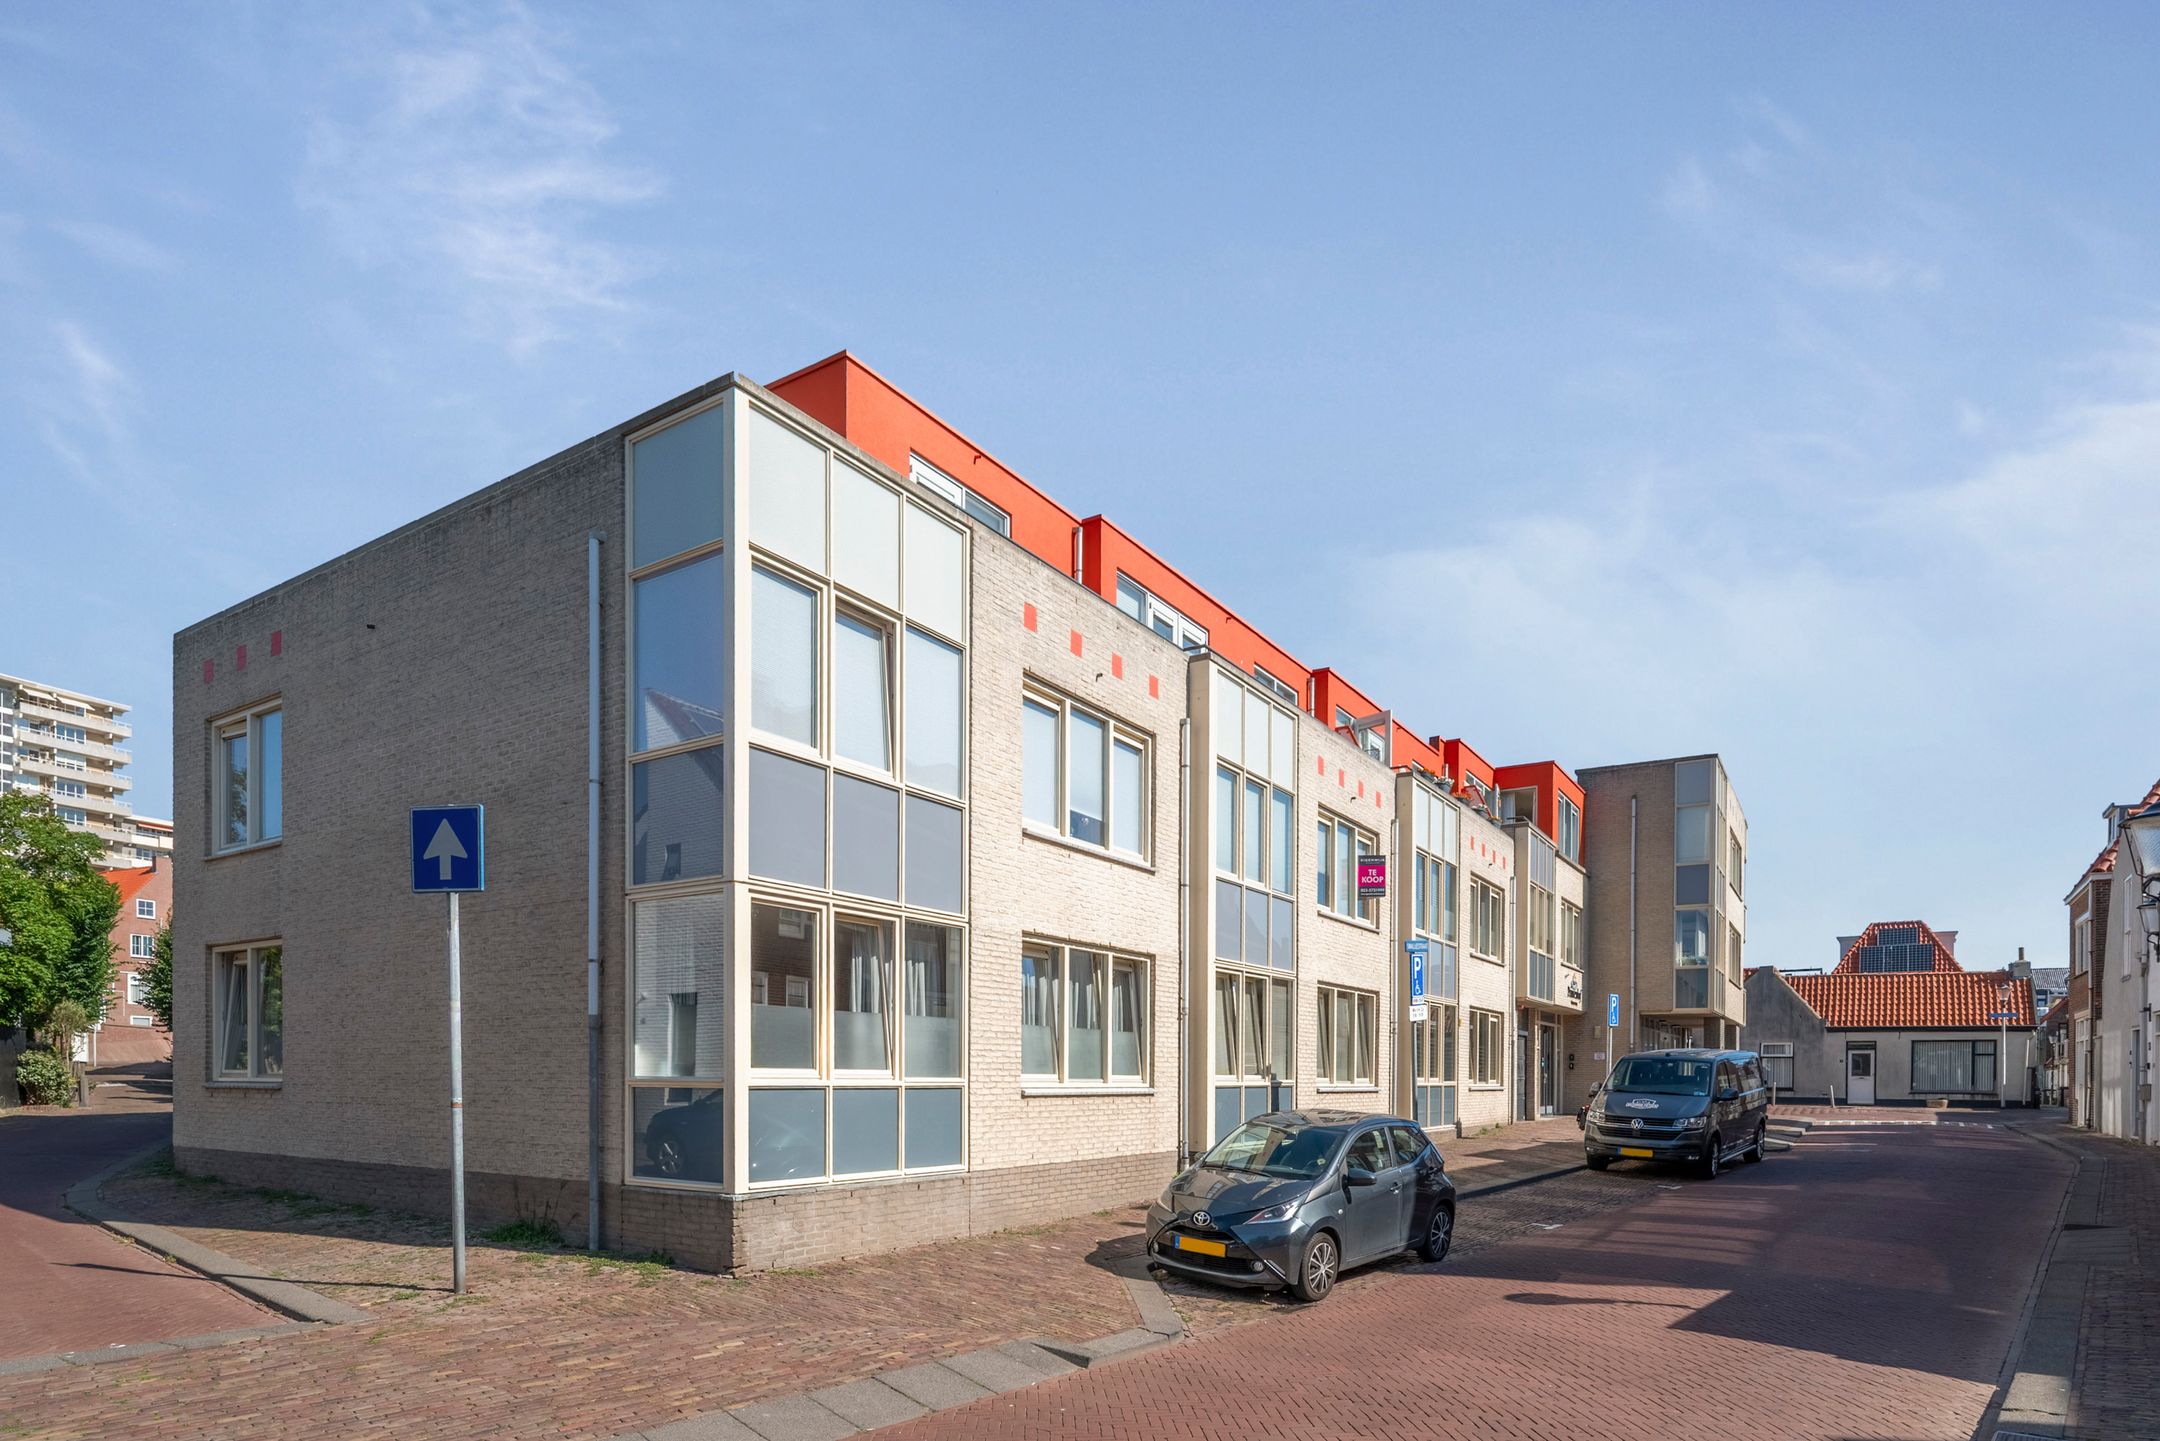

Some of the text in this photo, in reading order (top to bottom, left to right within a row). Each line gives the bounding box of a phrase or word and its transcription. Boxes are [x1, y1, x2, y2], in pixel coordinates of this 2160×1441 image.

[1361, 876, 1384, 884] KOOP
[1414, 957, 1422, 979] P
[1611, 996, 1617, 1012] P
